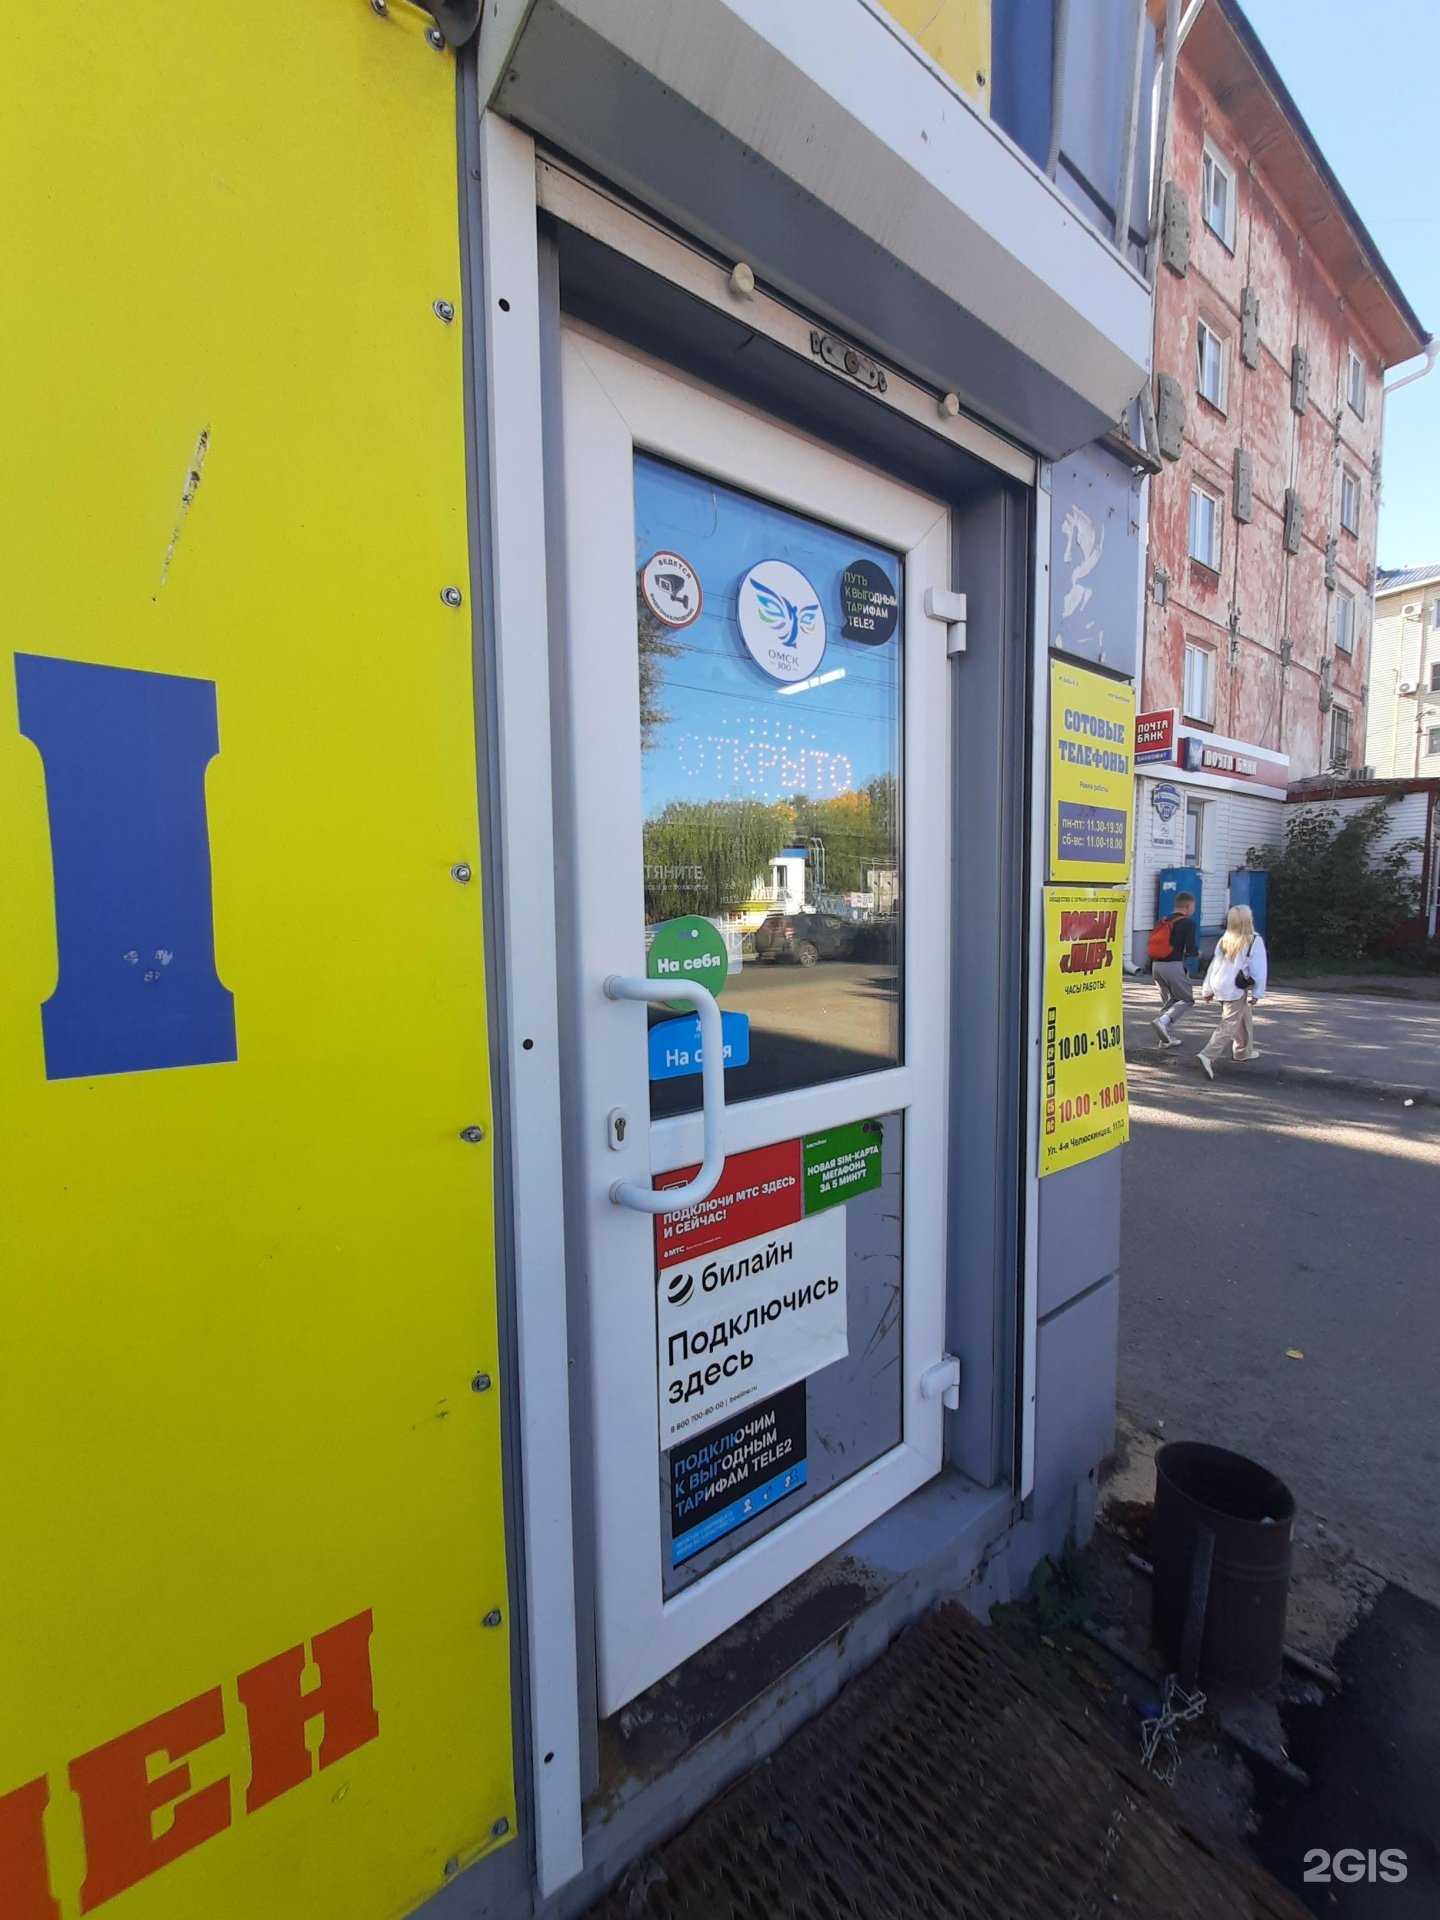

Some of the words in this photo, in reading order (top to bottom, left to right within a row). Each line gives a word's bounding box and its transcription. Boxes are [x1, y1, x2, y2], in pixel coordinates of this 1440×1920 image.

[844, 571, 868, 587] ПУТЬ
[846, 600, 889, 618] ТАРИФАМ
[848, 616, 875, 630] TELE2
[768, 648, 800, 666] ОМСК
[1064, 708, 1125, 744] СОТОВЫЕ
[1137, 719, 1168, 733] ПОЧТА
[1137, 731, 1164, 744] БАНК
[678, 733, 852, 792] ОТКРЫТО
[1058, 738, 1129, 774] ТЕЛЕФОНЫ
[657, 958, 679, 974] На
[684, 953, 721, 970] себя
[666, 1049, 689, 1068] На
[694, 1044, 732, 1063] ся
[1058, 1033, 1088, 1060] 10.00
[1096, 1025, 1121, 1050] 19.30
[1059, 1093, 1090, 1123] 10.00
[1099, 1082, 1125, 1109] 18.00
[807, 1159, 836, 1176] НОВАЯ
[837, 1145, 879, 1166] SIM-КАРТА
[822, 1159, 866, 1181] МЕГАФОНА
[819, 1183, 831, 1193] ЗА
[832, 1179, 838, 1189] 5
[839, 1168, 867, 1186] МИНУТ
[663, 1195, 734, 1225] ПОДКЛЮЧИ
[736, 1187, 760, 1202] МТС
[762, 1176, 796, 1194] ЗДЕСЬ
[663, 1227, 673, 1239] И
[676, 1209, 727, 1235] СЕЙЧАС!
[701, 1240, 793, 1293] билайн
[668, 1275, 839, 1367] Подключись
[668, 1350, 754, 1404] здесь
[674, 1410, 776, 1478] ПОДКЛЮЧИМ
[674, 1463, 749, 1518] ТАРИФАМ
[752, 1438, 793, 1472] TELE2
[675, 1480, 685, 1498] К
[689, 1428, 777, 1490] ВЫГОДНЫМ
